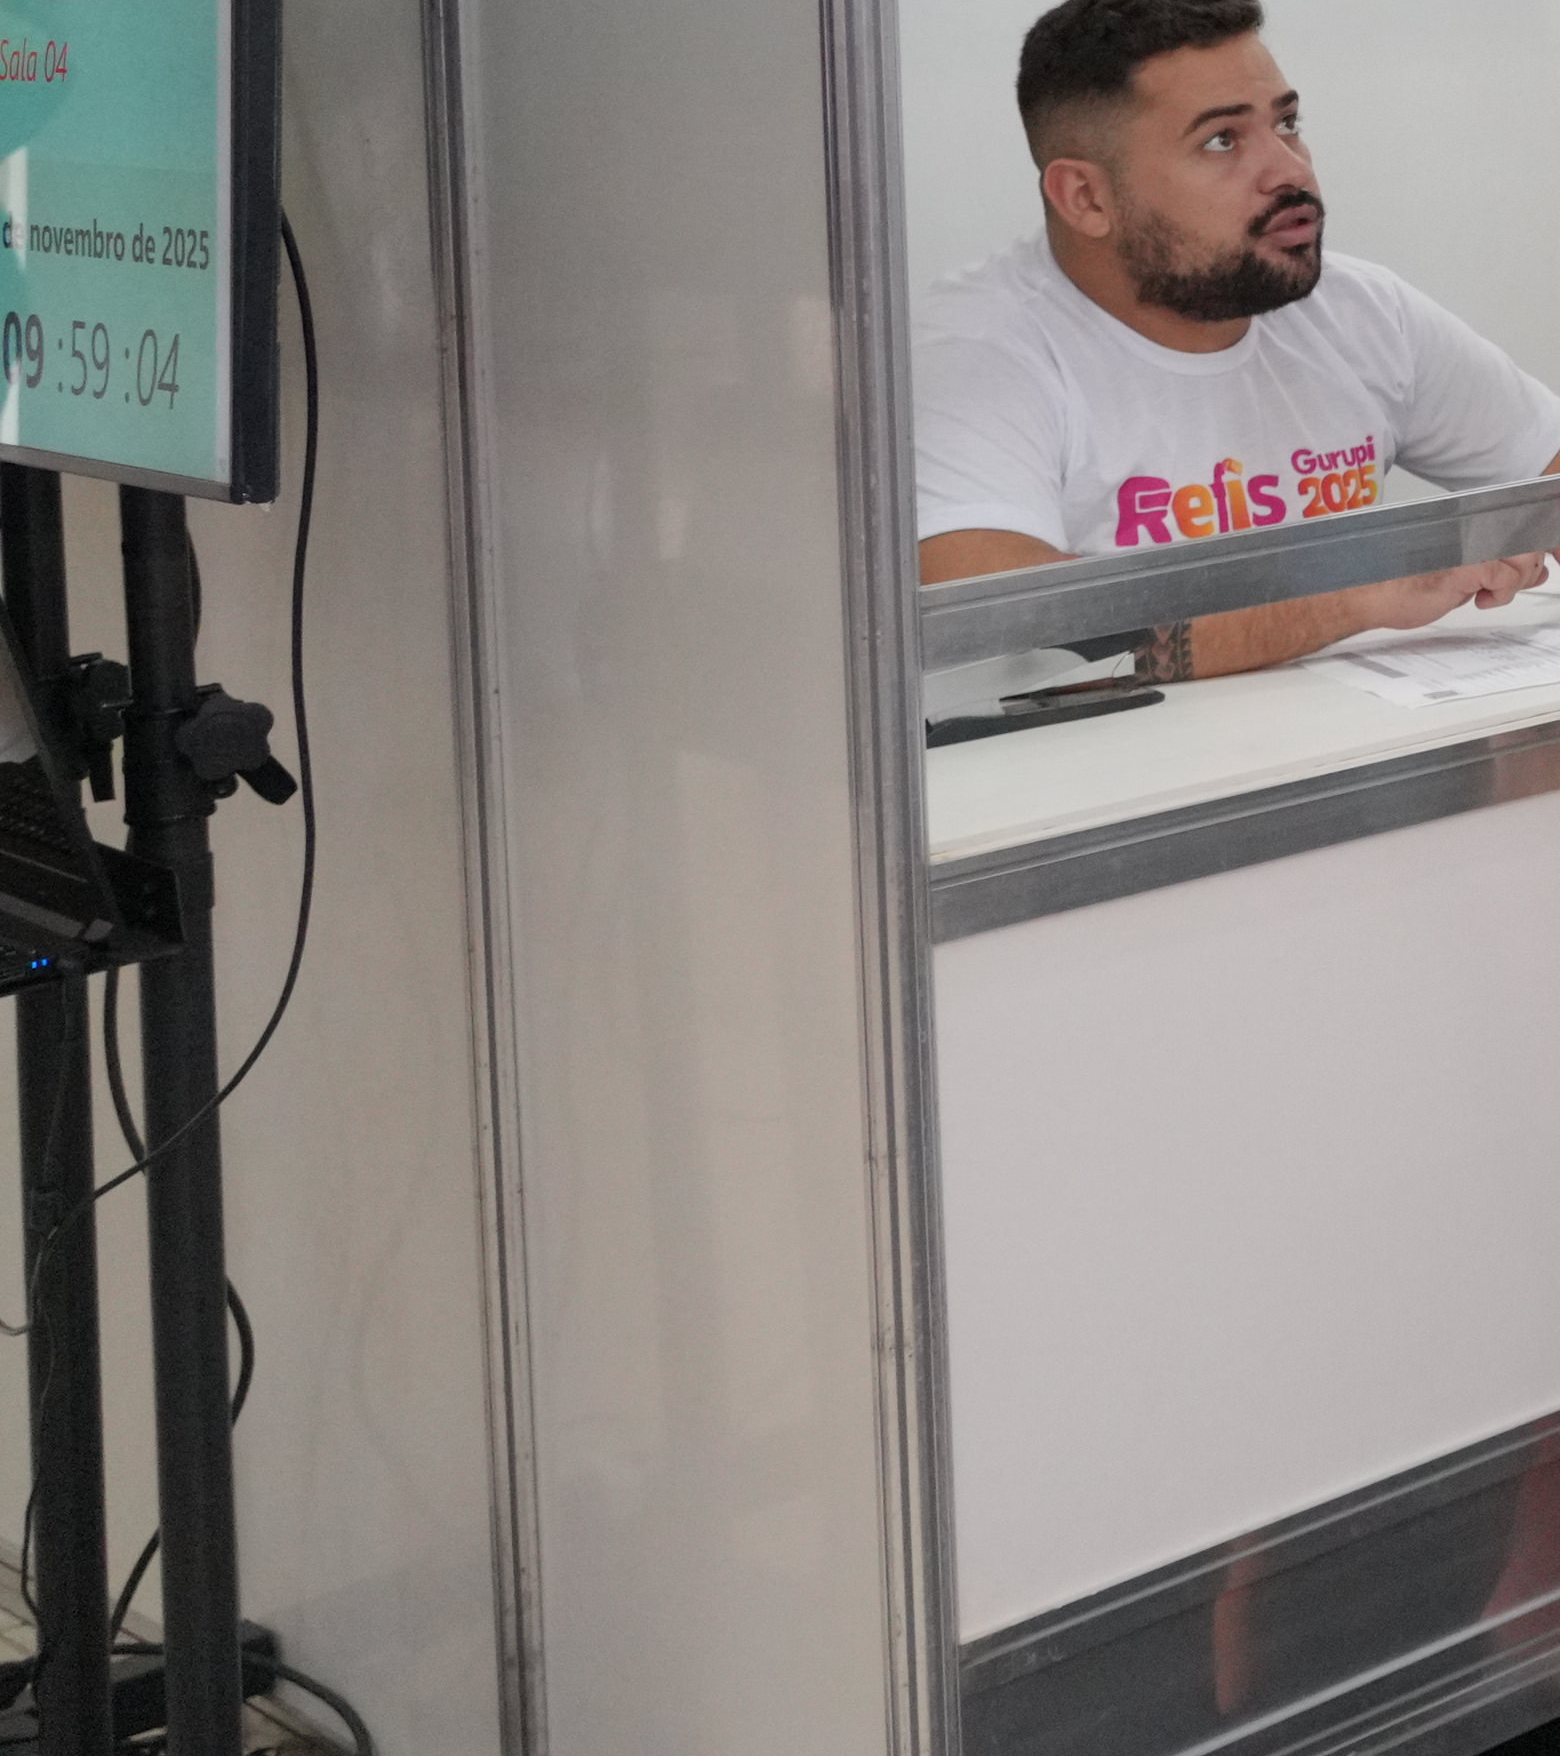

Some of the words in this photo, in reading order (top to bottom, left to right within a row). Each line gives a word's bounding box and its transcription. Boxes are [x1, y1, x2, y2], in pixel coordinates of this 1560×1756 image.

[0, 36, 37, 82] Sala
[44, 40, 68, 83] 04
[30, 218, 125, 261] novembro
[132, 220, 156, 265] de
[162, 224, 210, 271] 2025
[1291, 436, 1375, 475] Gurupi
[1115, 458, 1286, 546] Refis
[1297, 464, 1378, 518] 2025
